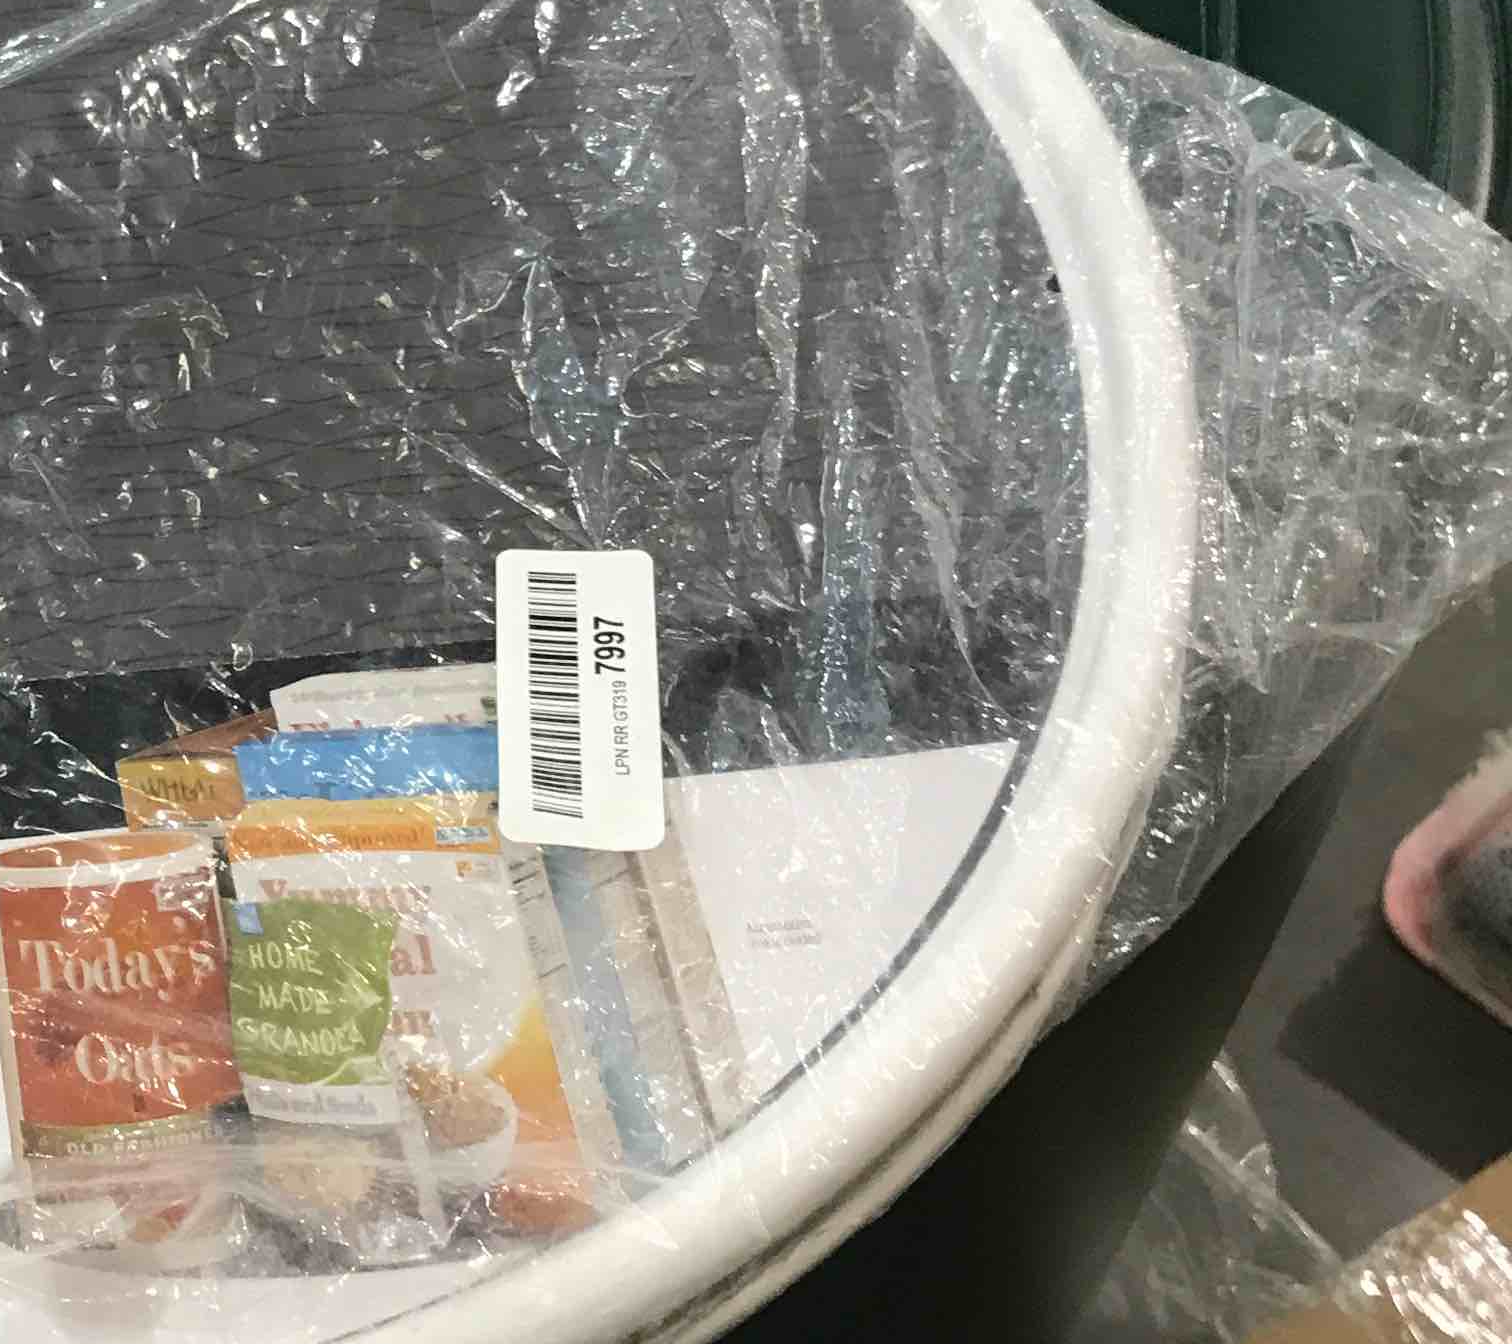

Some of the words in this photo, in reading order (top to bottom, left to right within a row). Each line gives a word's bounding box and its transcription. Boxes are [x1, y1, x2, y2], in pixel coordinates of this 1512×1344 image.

[593, 616, 626, 674] 7997
[614, 725, 629, 745] RR
[614, 748, 631, 776] LPN
[248, 940, 324, 976] HOME
[257, 981, 333, 1015] MADE
